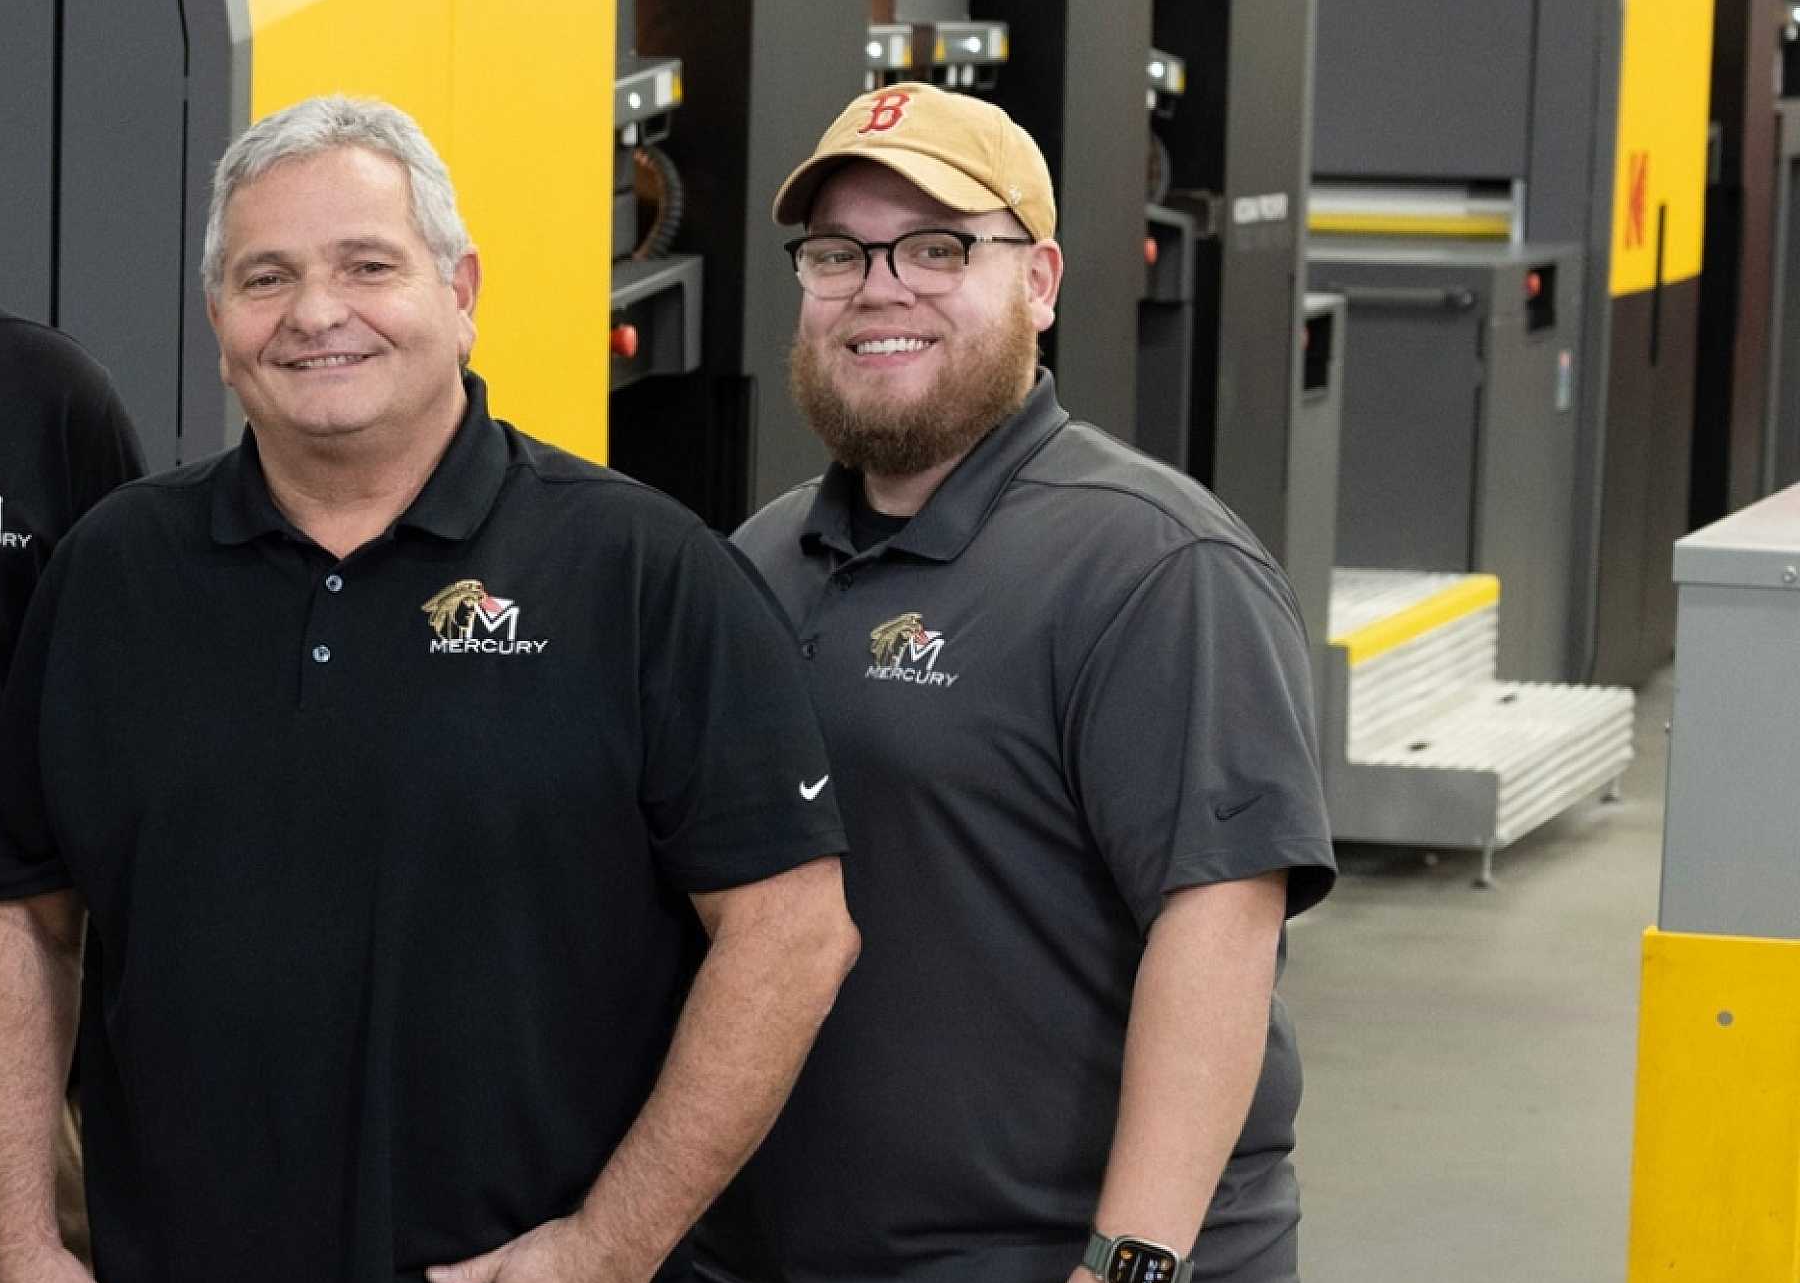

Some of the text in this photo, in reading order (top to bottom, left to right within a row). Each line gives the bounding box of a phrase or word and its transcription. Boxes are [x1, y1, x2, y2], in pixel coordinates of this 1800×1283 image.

[857, 93, 910, 134] B
[430, 638, 549, 654] MERCURY
[865, 665, 960, 687] MERCURY
